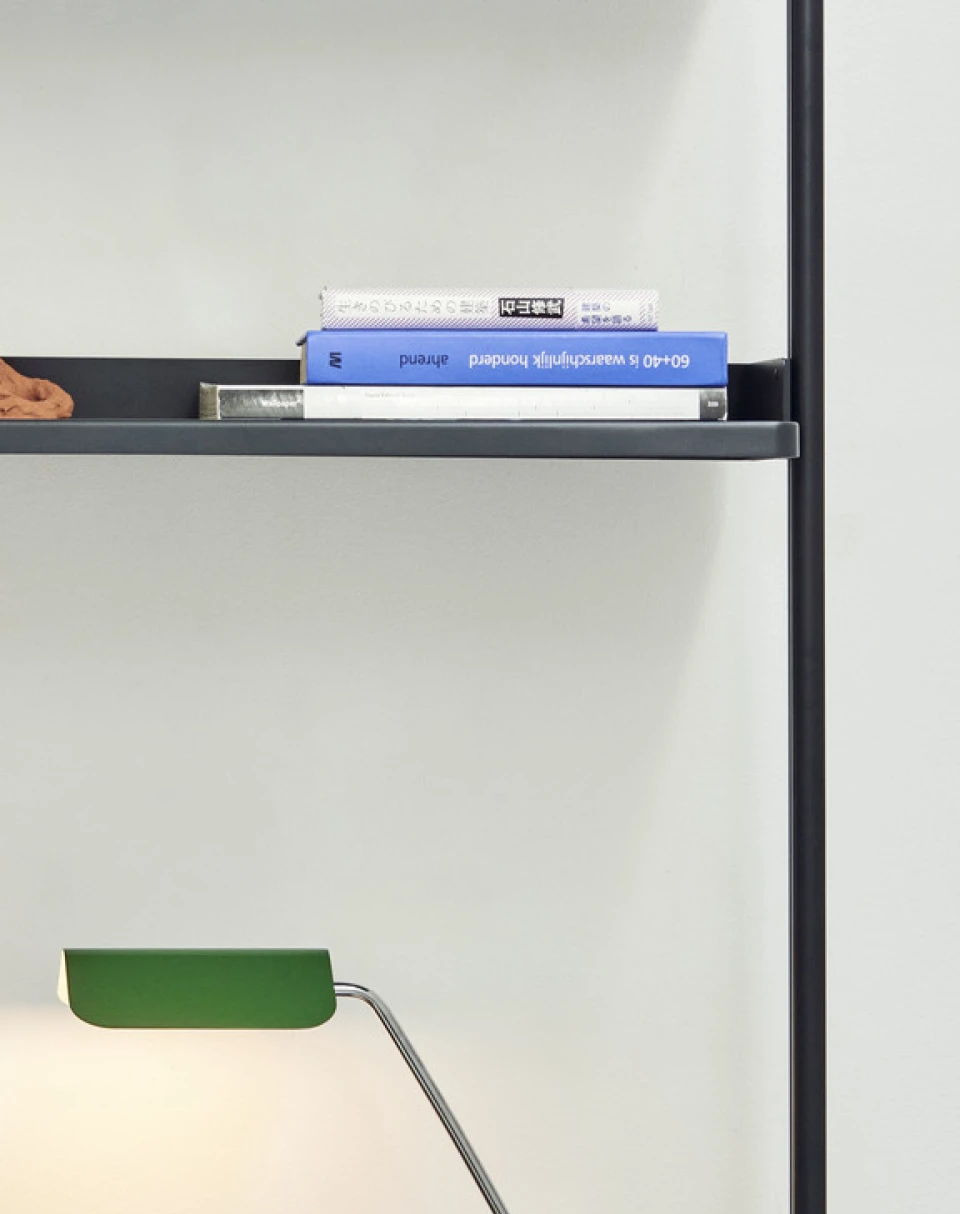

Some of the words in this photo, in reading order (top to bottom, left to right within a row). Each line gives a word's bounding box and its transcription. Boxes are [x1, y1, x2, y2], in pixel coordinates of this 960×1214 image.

[399, 353, 449, 369] ahrend
[468, 353, 529, 370] honderd
[532, 351, 626, 370] waarschijnlijk
[630, 353, 639, 368] is
[643, 353, 691, 368] 60+40
